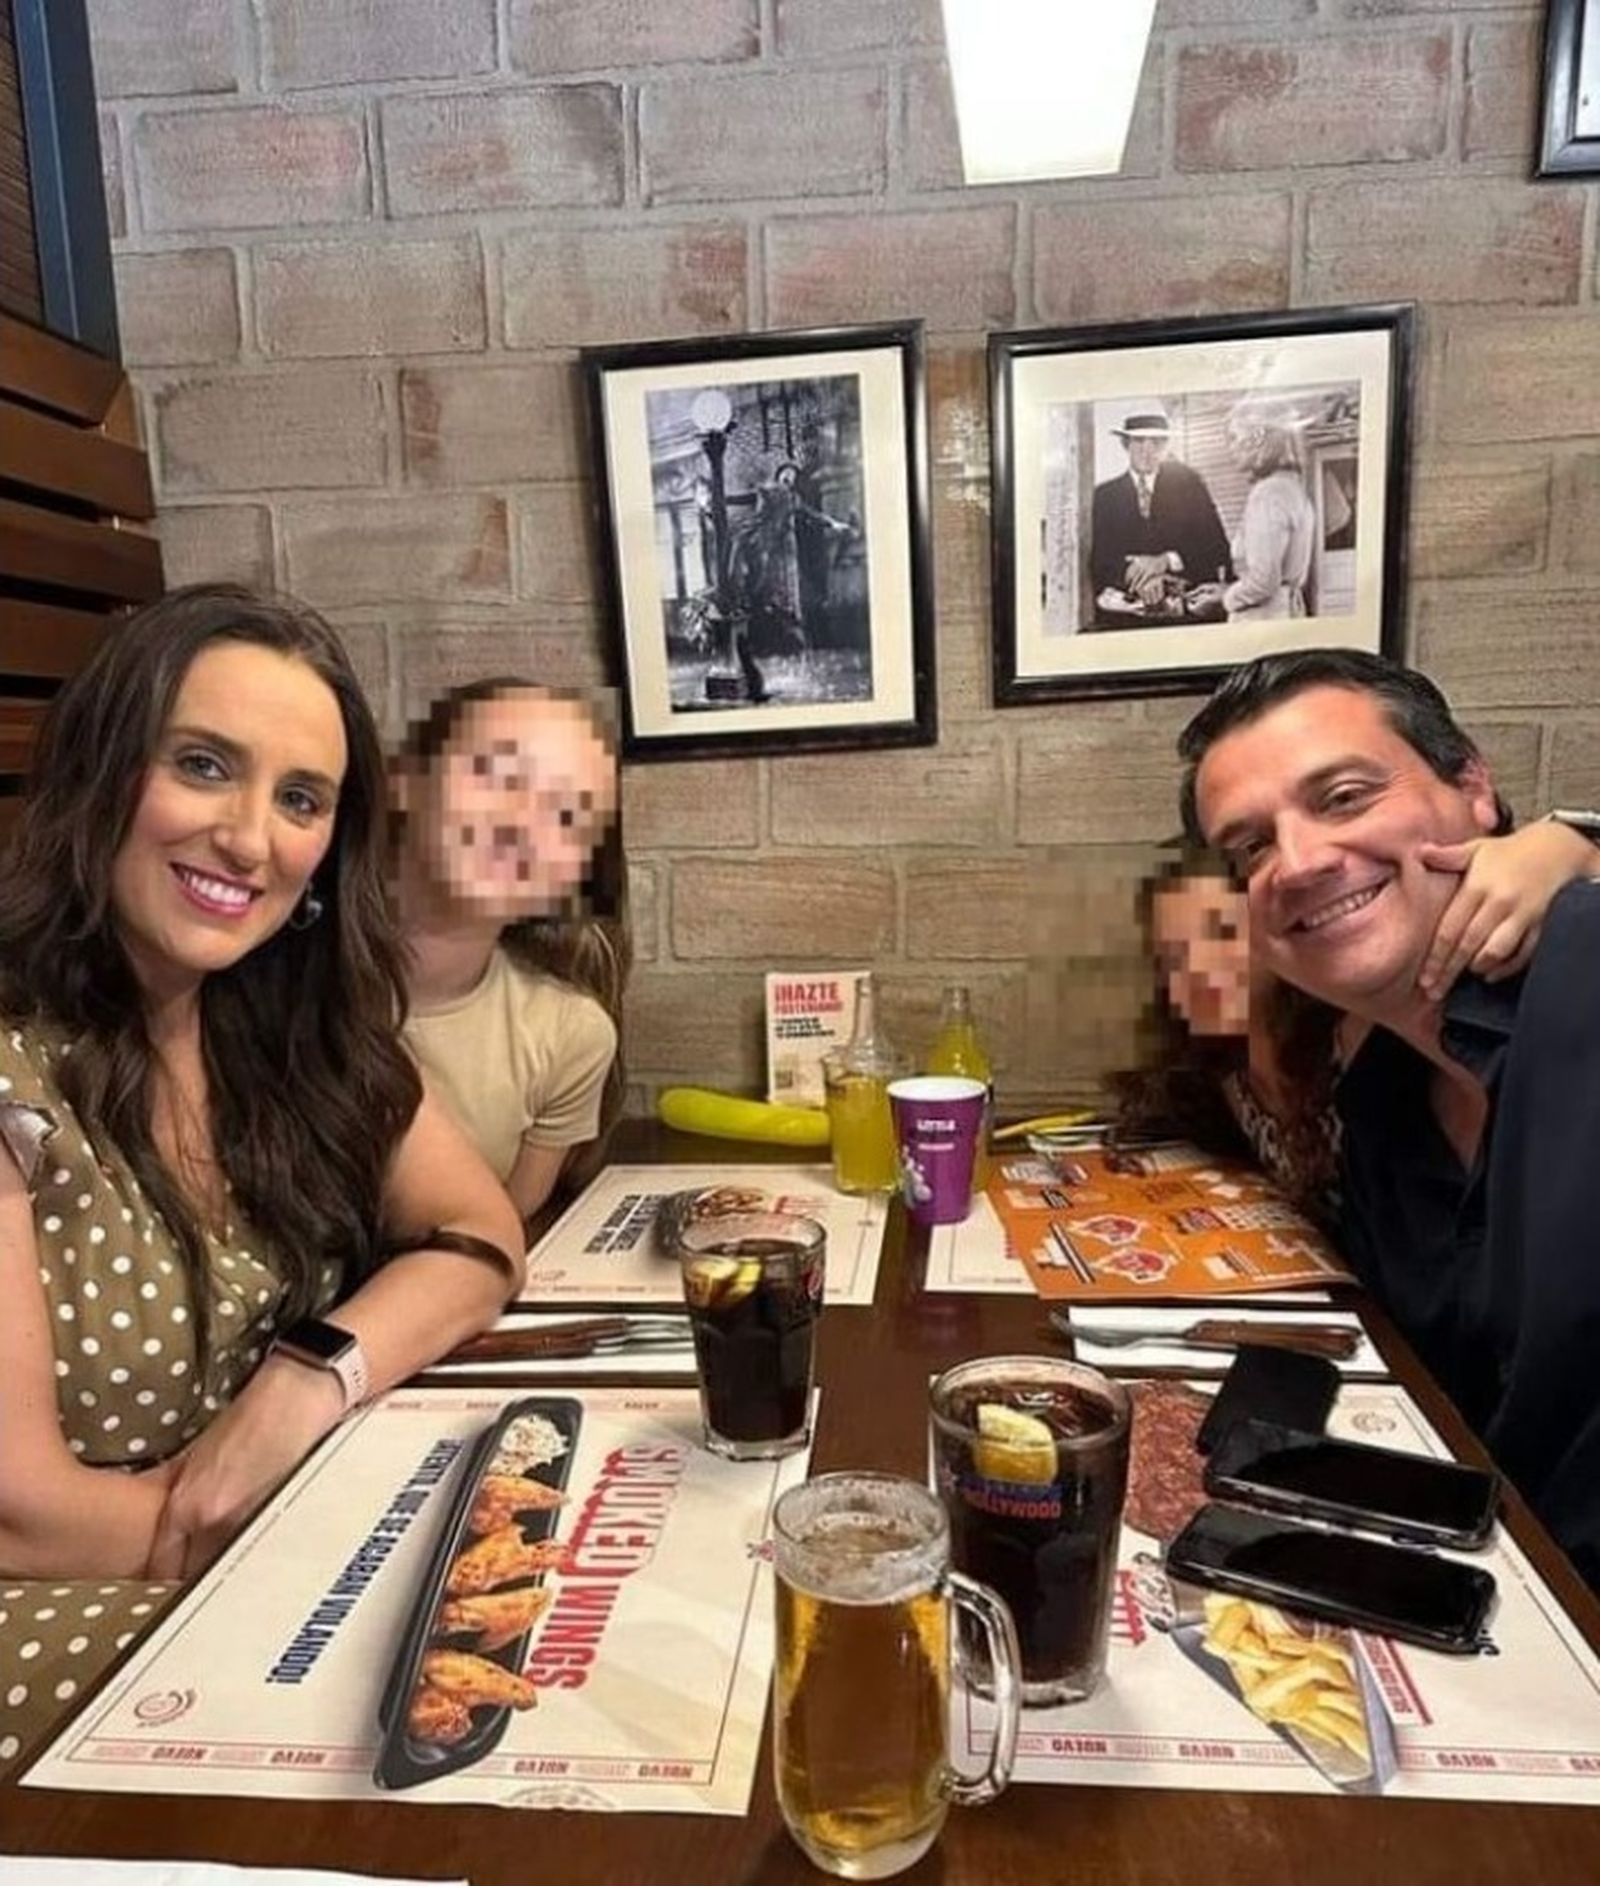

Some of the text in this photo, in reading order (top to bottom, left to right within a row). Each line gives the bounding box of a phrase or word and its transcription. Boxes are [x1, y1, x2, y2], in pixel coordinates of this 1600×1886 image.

[373, 1517, 411, 1533] SE
[556, 1440, 690, 1577] SMOKED
[328, 1535, 399, 1596] ACABAN
[265, 1598, 357, 1684] VOLANDO!
[524, 1584, 620, 1690] WINGS
[1051, 1738, 1108, 1753] NUEVO
[513, 1759, 570, 1775] NUEVO
[637, 1763, 694, 1779] NUEVO
